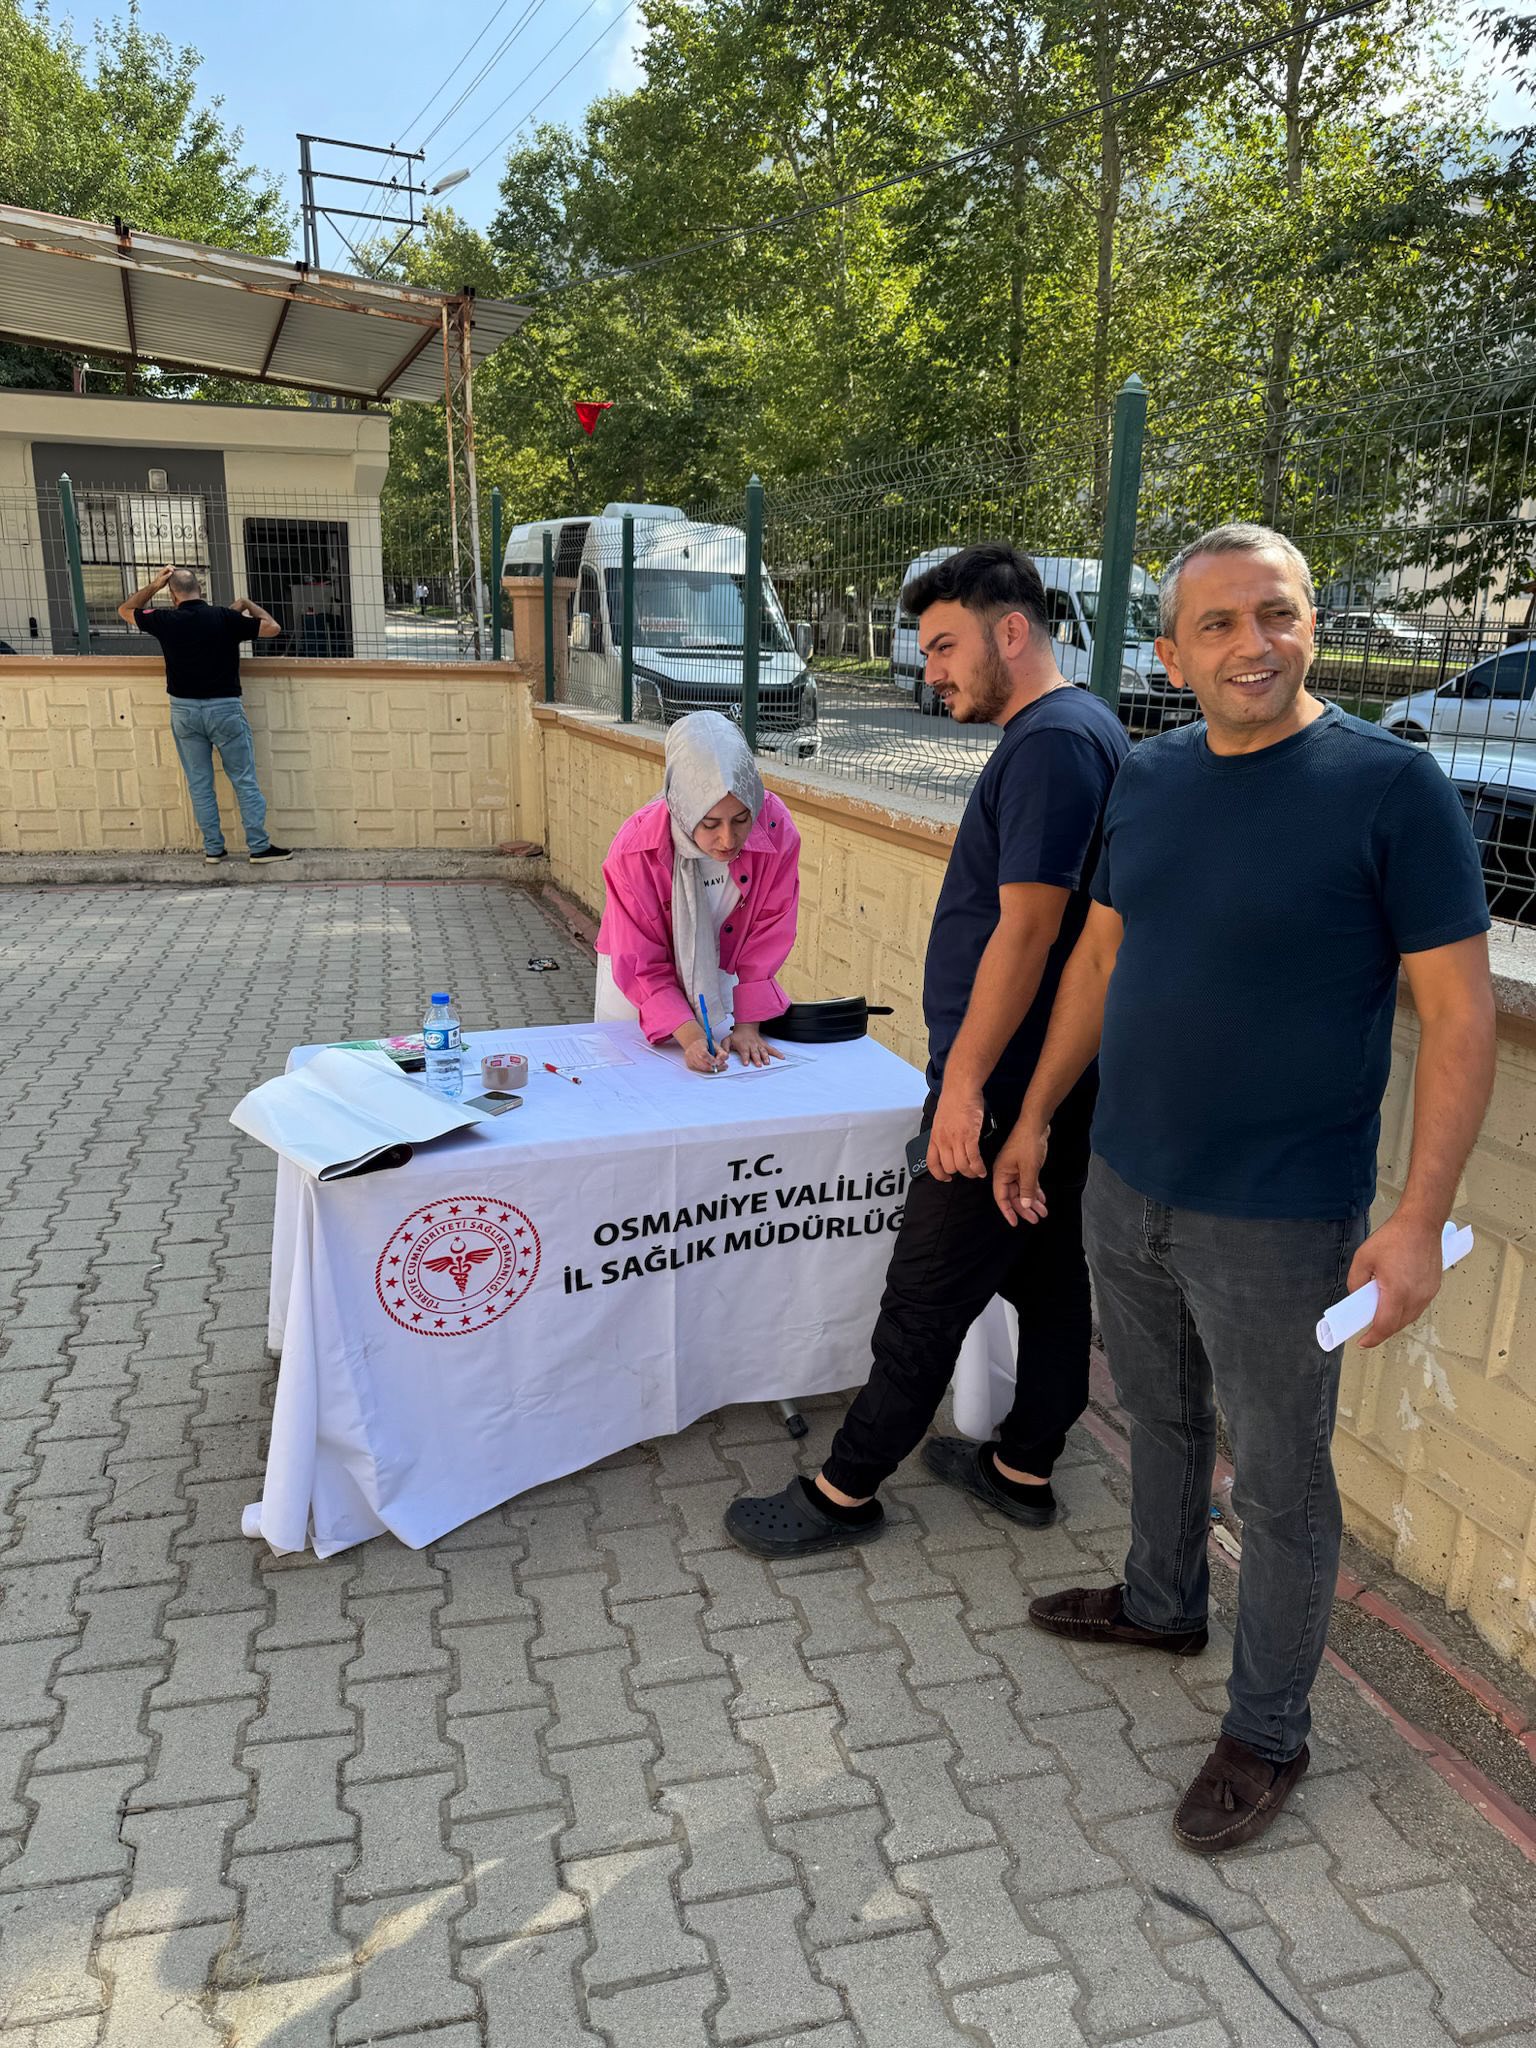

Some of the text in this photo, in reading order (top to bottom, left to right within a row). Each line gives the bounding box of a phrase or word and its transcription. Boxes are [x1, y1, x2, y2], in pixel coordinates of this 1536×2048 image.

[728, 1154, 783, 1181] T.C.
[470, 1221, 505, 1244] SAĞLIK
[594, 1167, 906, 1247] OSMANİYE VALİLİĞİ
[407, 1220, 466, 1275] CUMHURİYETİ
[486, 1243, 512, 1294] BAKANLIĞI
[564, 1204, 906, 1294] İL SAĞLIK MÜDÜRLÜĞ
